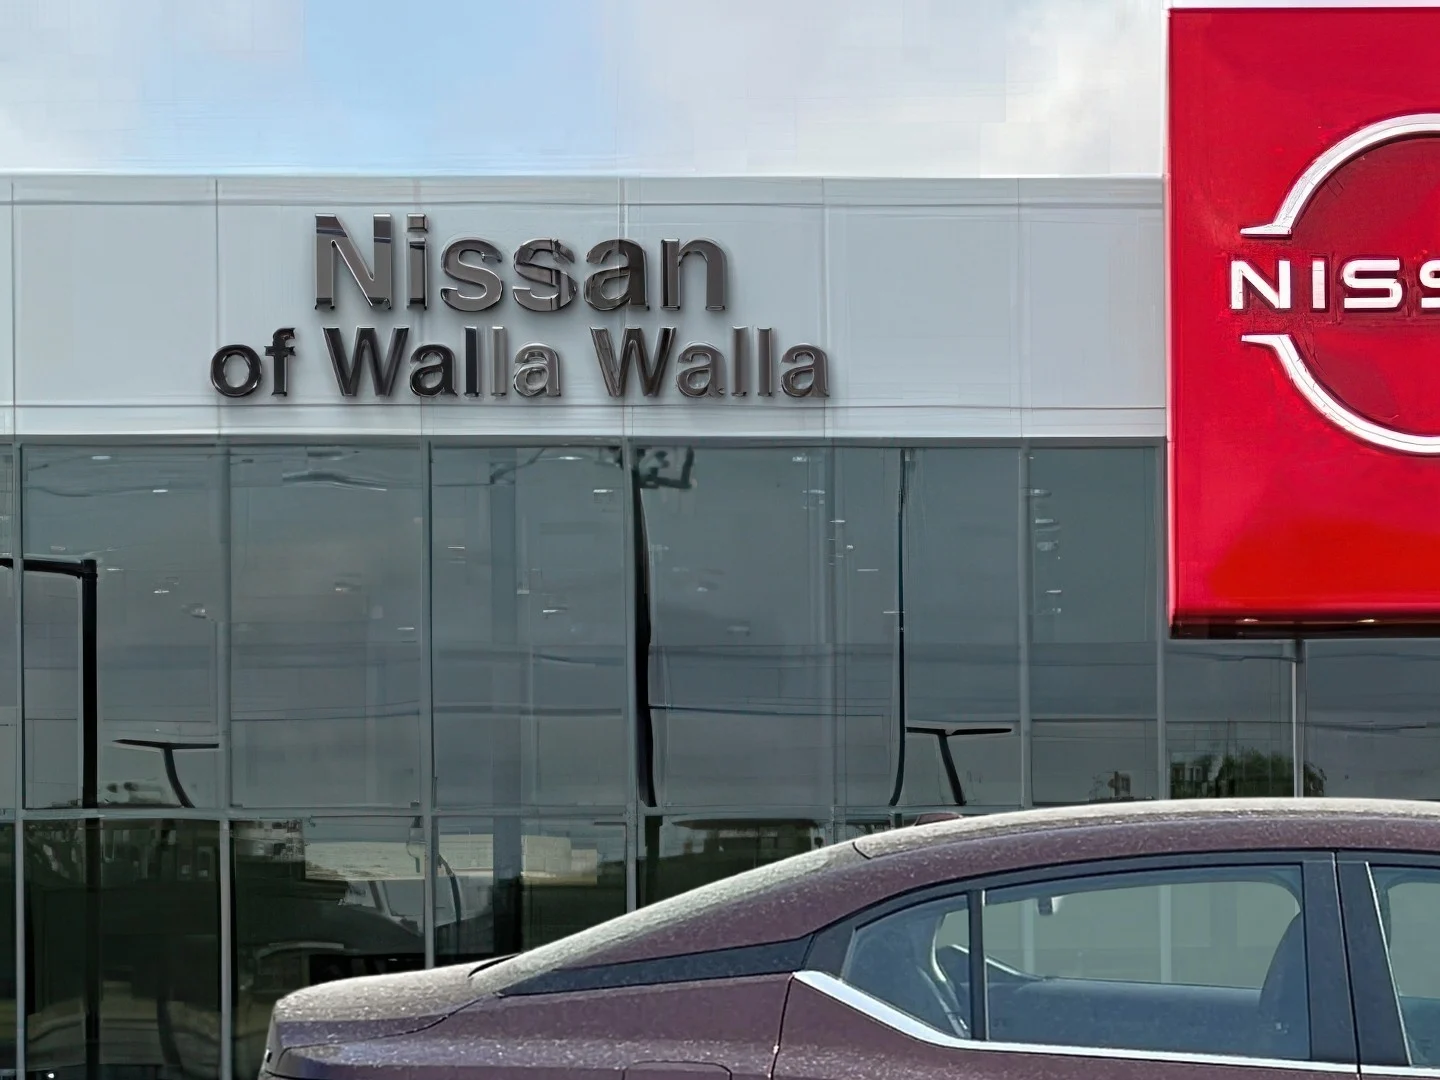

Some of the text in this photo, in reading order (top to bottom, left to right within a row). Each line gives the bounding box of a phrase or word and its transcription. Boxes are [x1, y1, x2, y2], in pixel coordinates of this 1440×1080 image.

[313, 212, 727, 312] Nissan
[210, 326, 830, 398] of Walla Walla
